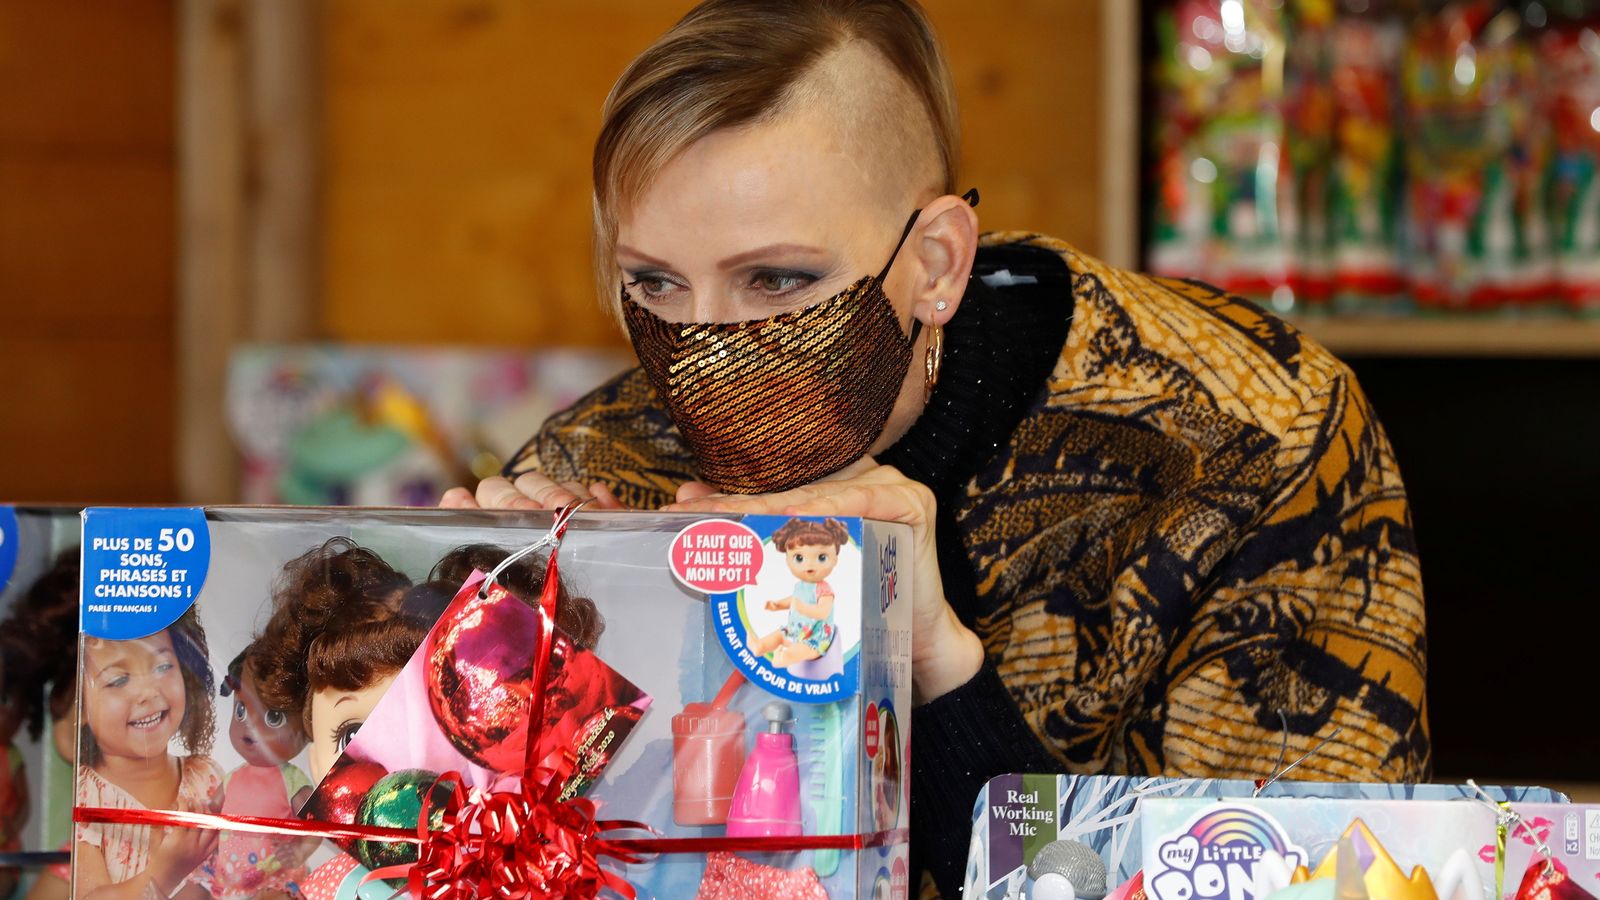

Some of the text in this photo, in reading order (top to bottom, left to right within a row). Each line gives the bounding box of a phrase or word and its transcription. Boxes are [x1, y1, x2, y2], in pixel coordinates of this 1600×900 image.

[93, 528, 195, 552] PLUS DE 50
[682, 534, 753, 549] IL FAUT QUE
[120, 553, 167, 568] SONS,
[728, 551, 752, 565] SUR
[100, 569, 187, 582] PHRASES ET
[686, 567, 750, 582] MON POT !
[94, 585, 192, 598] CHANSONS !
[113, 605, 152, 614] FRANÇAIS
[718, 601, 840, 695] ELLE FAIT PIPI POUR DE VRAI !
[577, 706, 615, 756] Princesse de
[598, 730, 615, 754] 2020
[1007, 790, 1039, 804] Real
[992, 805, 1054, 823] Working
[1009, 822, 1037, 836] Mic
[1567, 842, 1577, 852] x2
[1167, 847, 1193, 864] my
